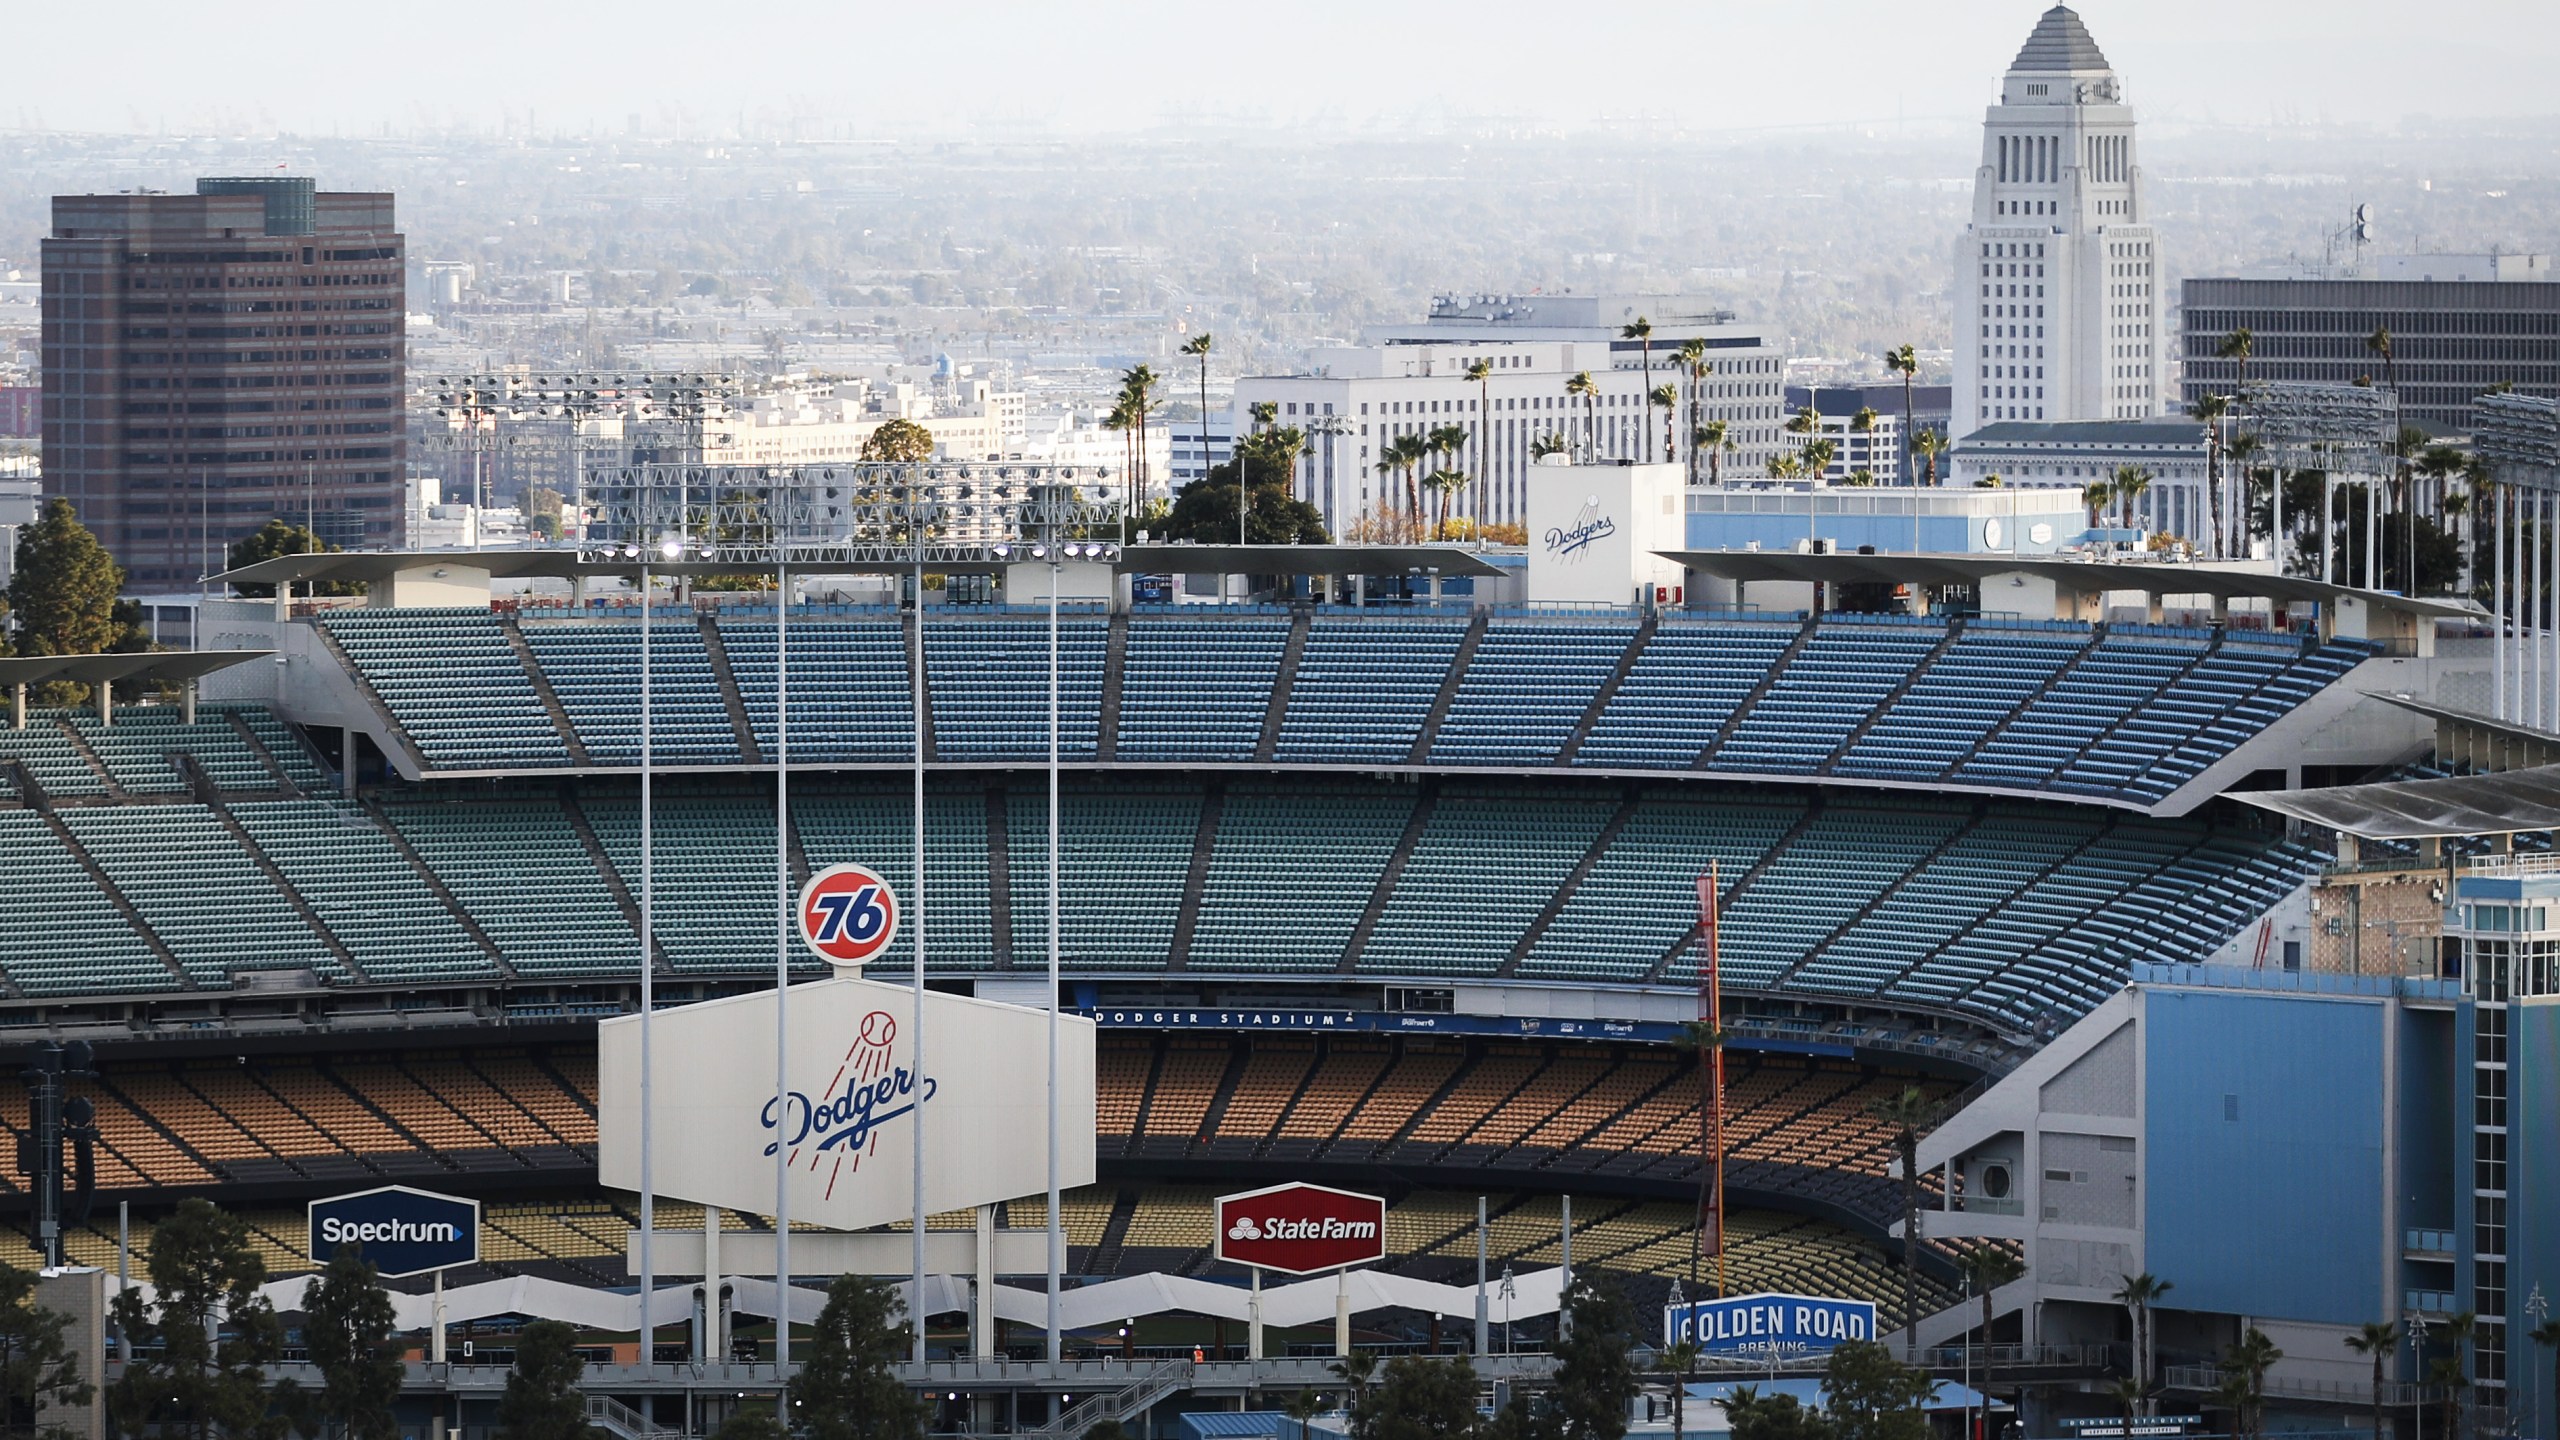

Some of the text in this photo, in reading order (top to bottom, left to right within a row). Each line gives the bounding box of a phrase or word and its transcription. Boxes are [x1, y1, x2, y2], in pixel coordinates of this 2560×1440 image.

[1544, 516, 1616, 555] Dodgers
[812, 884, 887, 944] 76
[1095, 1012, 1335, 1026] DODGER STADIUM
[322, 1217, 454, 1243] Spectrum
[1795, 1305, 1866, 1341] ROAD
[1738, 1341, 1808, 1353] BREWING
[2134, 1416, 2194, 1424] STADIUM
